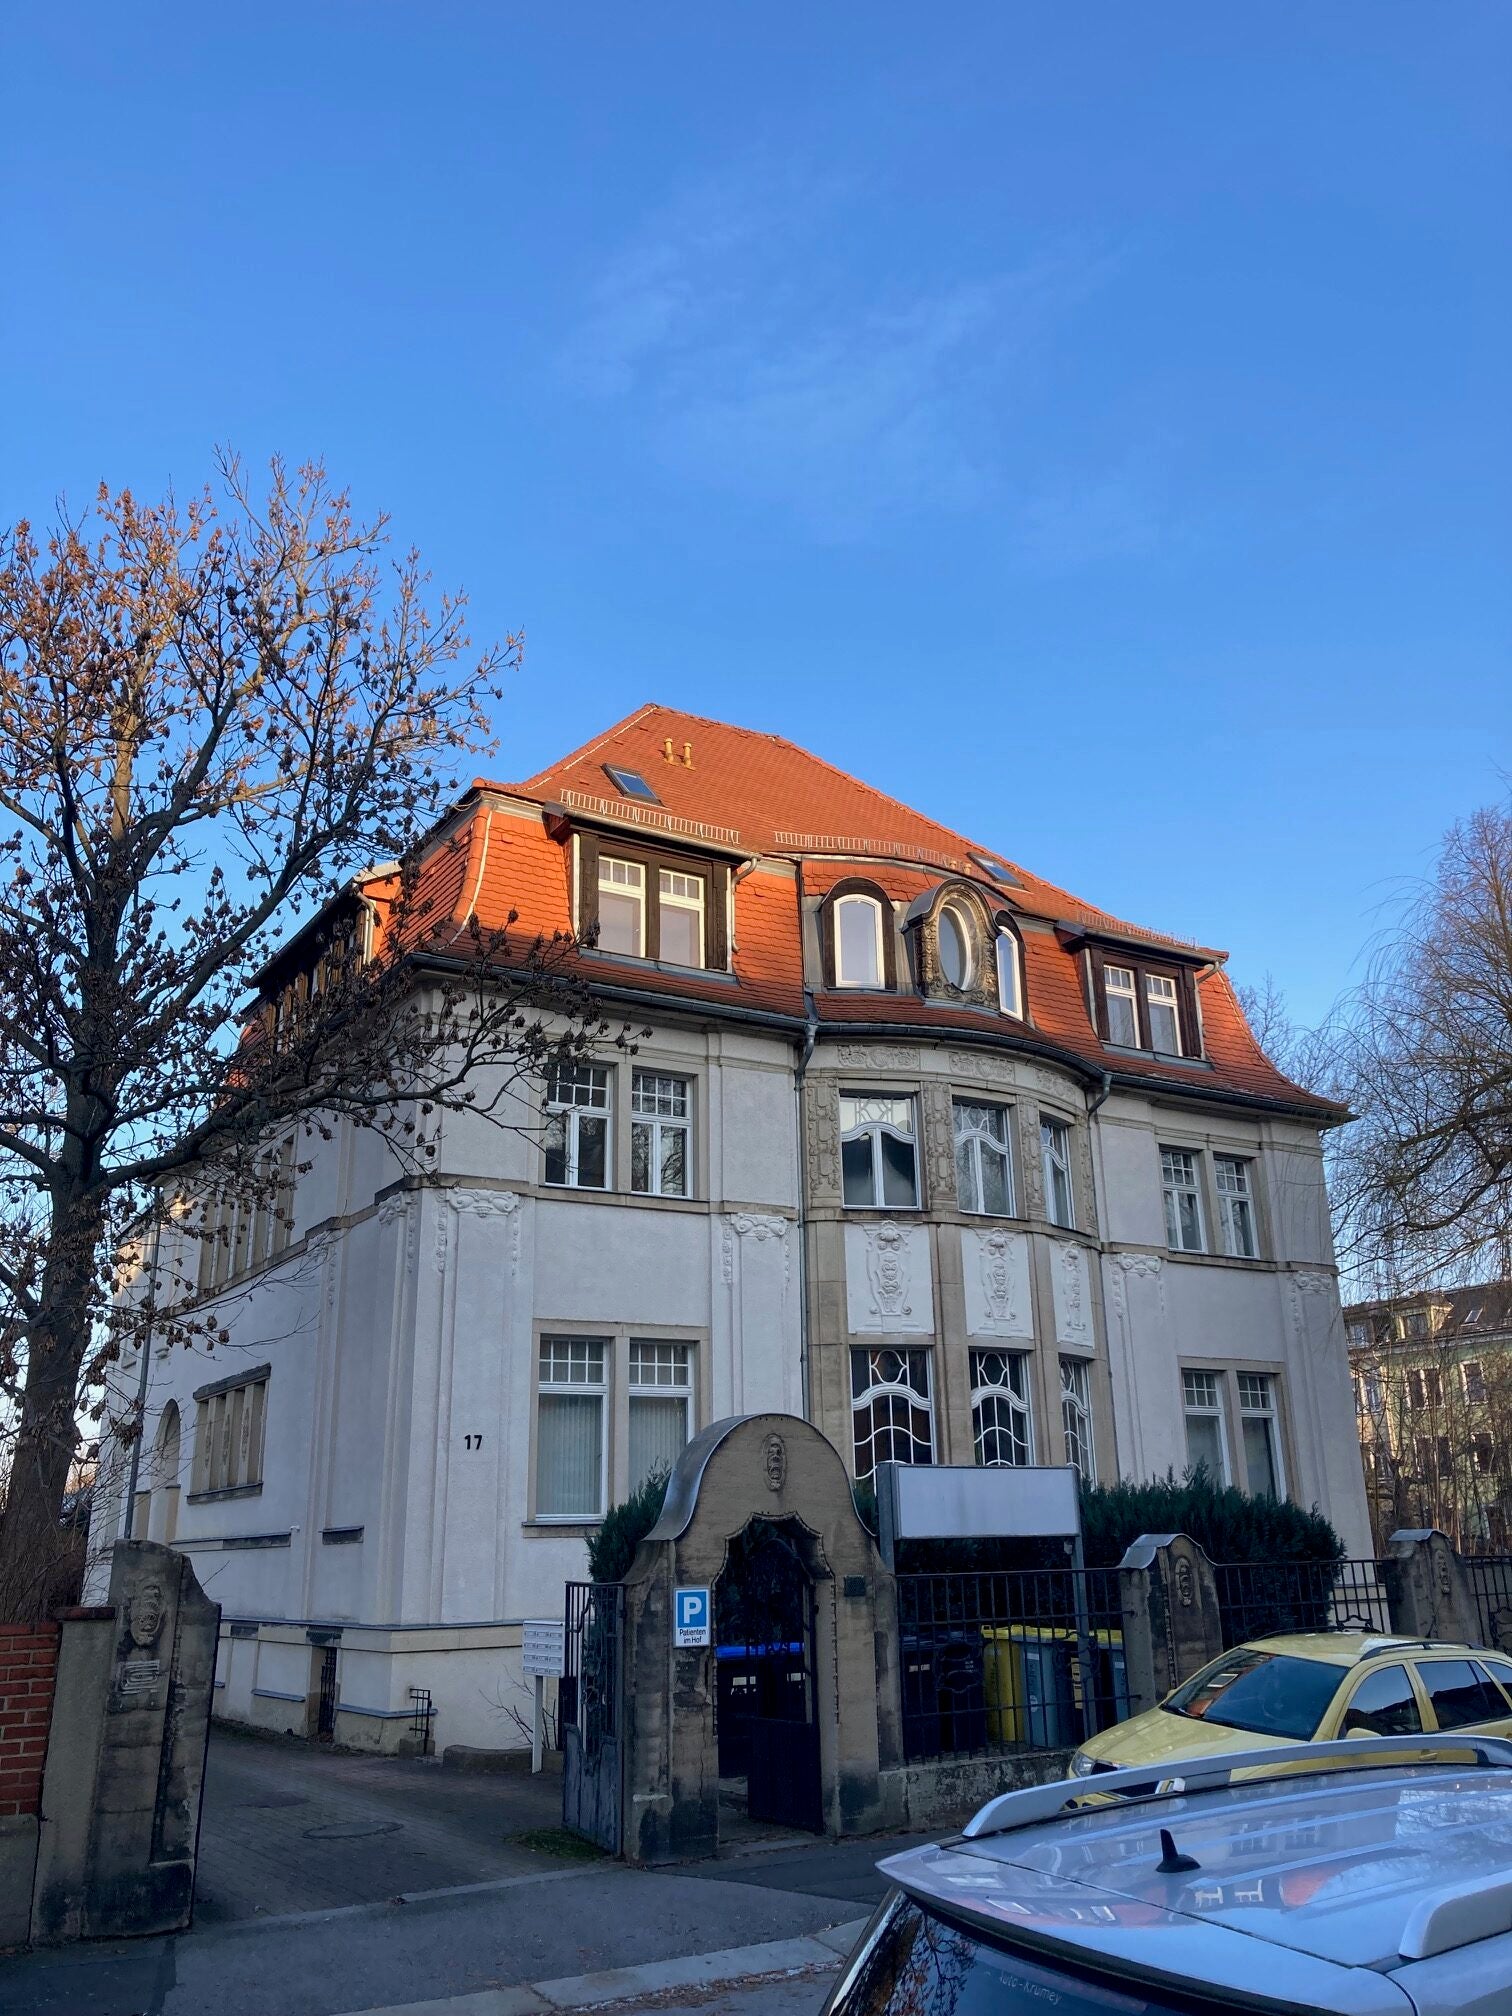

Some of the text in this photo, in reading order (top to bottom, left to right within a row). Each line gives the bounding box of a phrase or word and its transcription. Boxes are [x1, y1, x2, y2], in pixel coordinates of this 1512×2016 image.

[464, 1434, 483, 1450] 17
[683, 1596, 702, 1624] P
[680, 1628, 706, 1636] Patienten
